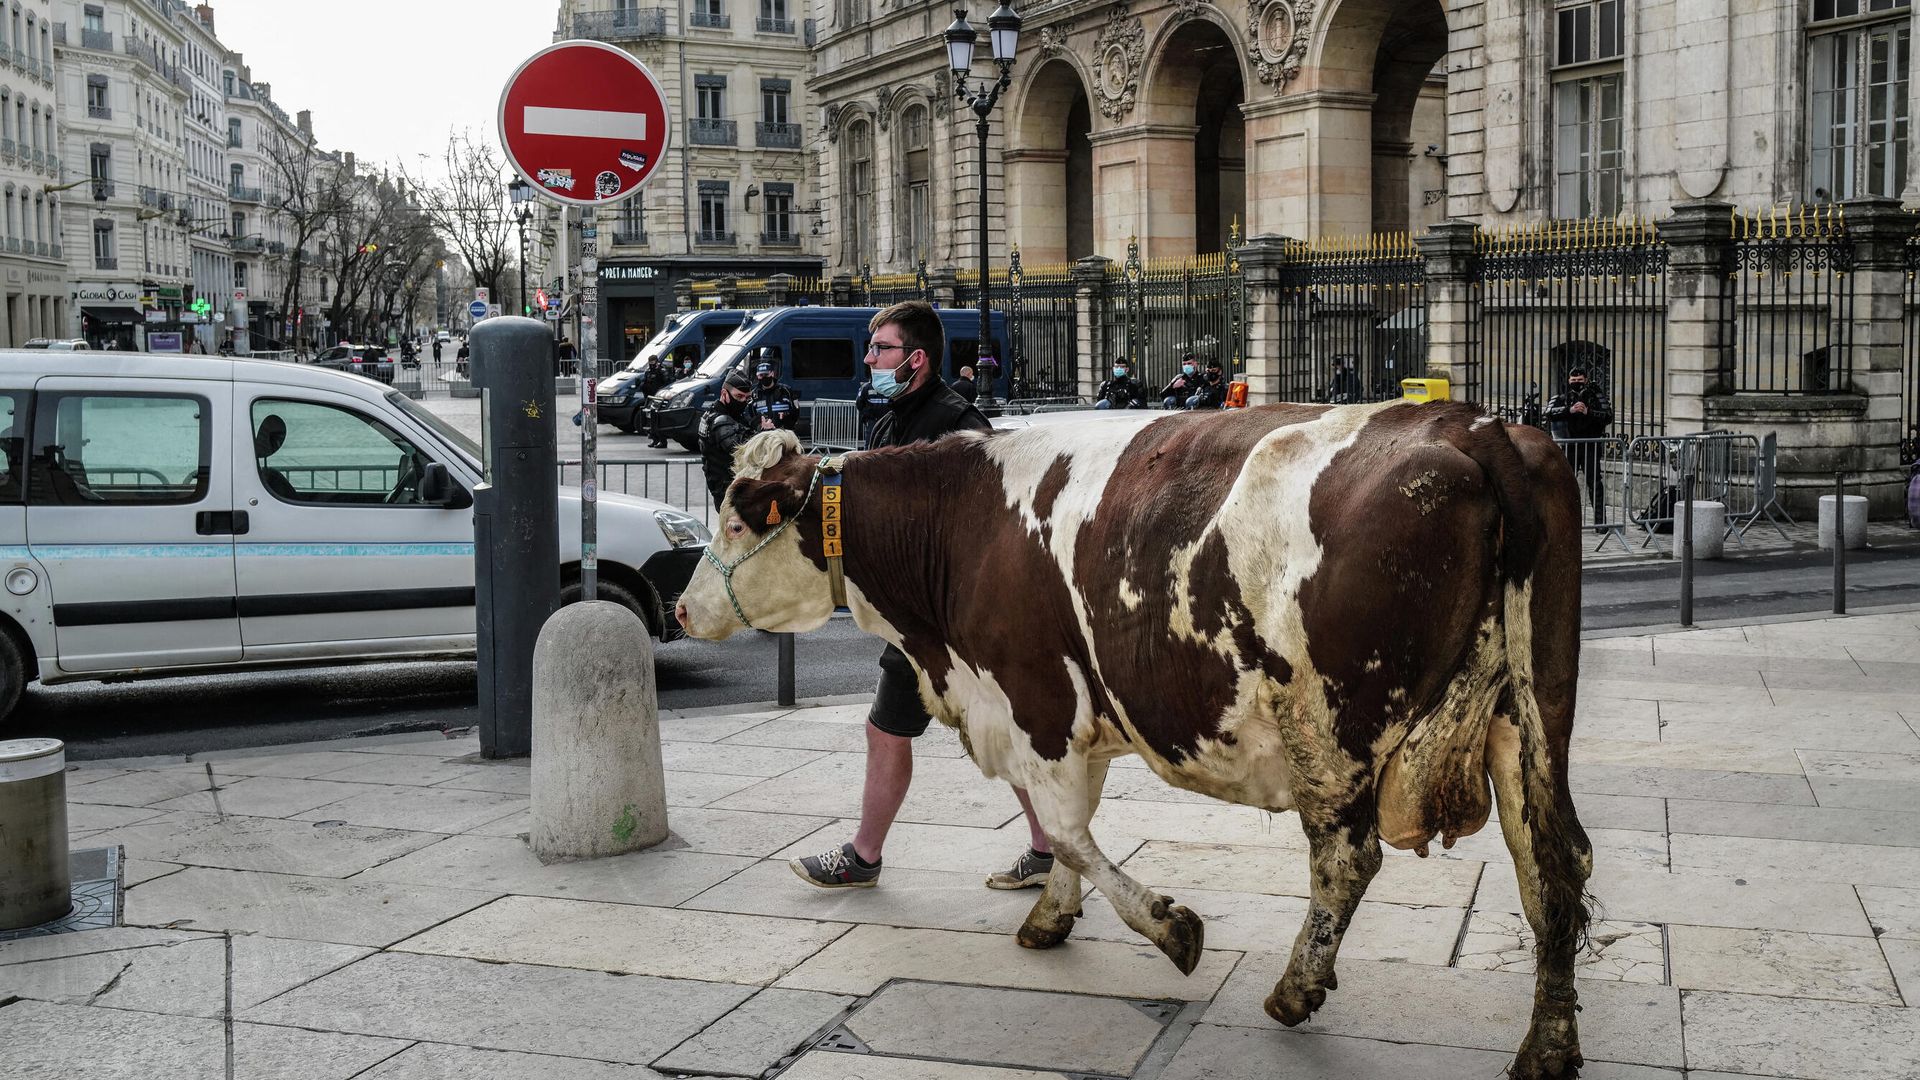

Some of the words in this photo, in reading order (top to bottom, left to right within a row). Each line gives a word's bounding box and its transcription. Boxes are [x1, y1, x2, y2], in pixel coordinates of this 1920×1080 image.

[605, 267, 619, 278] PRET
[621, 268, 626, 278] A
[627, 267, 652, 278] MANGER
[79, 289, 106, 300] GLOBAL
[117, 290, 137, 300] CASH
[826, 487, 838, 555] 5281
